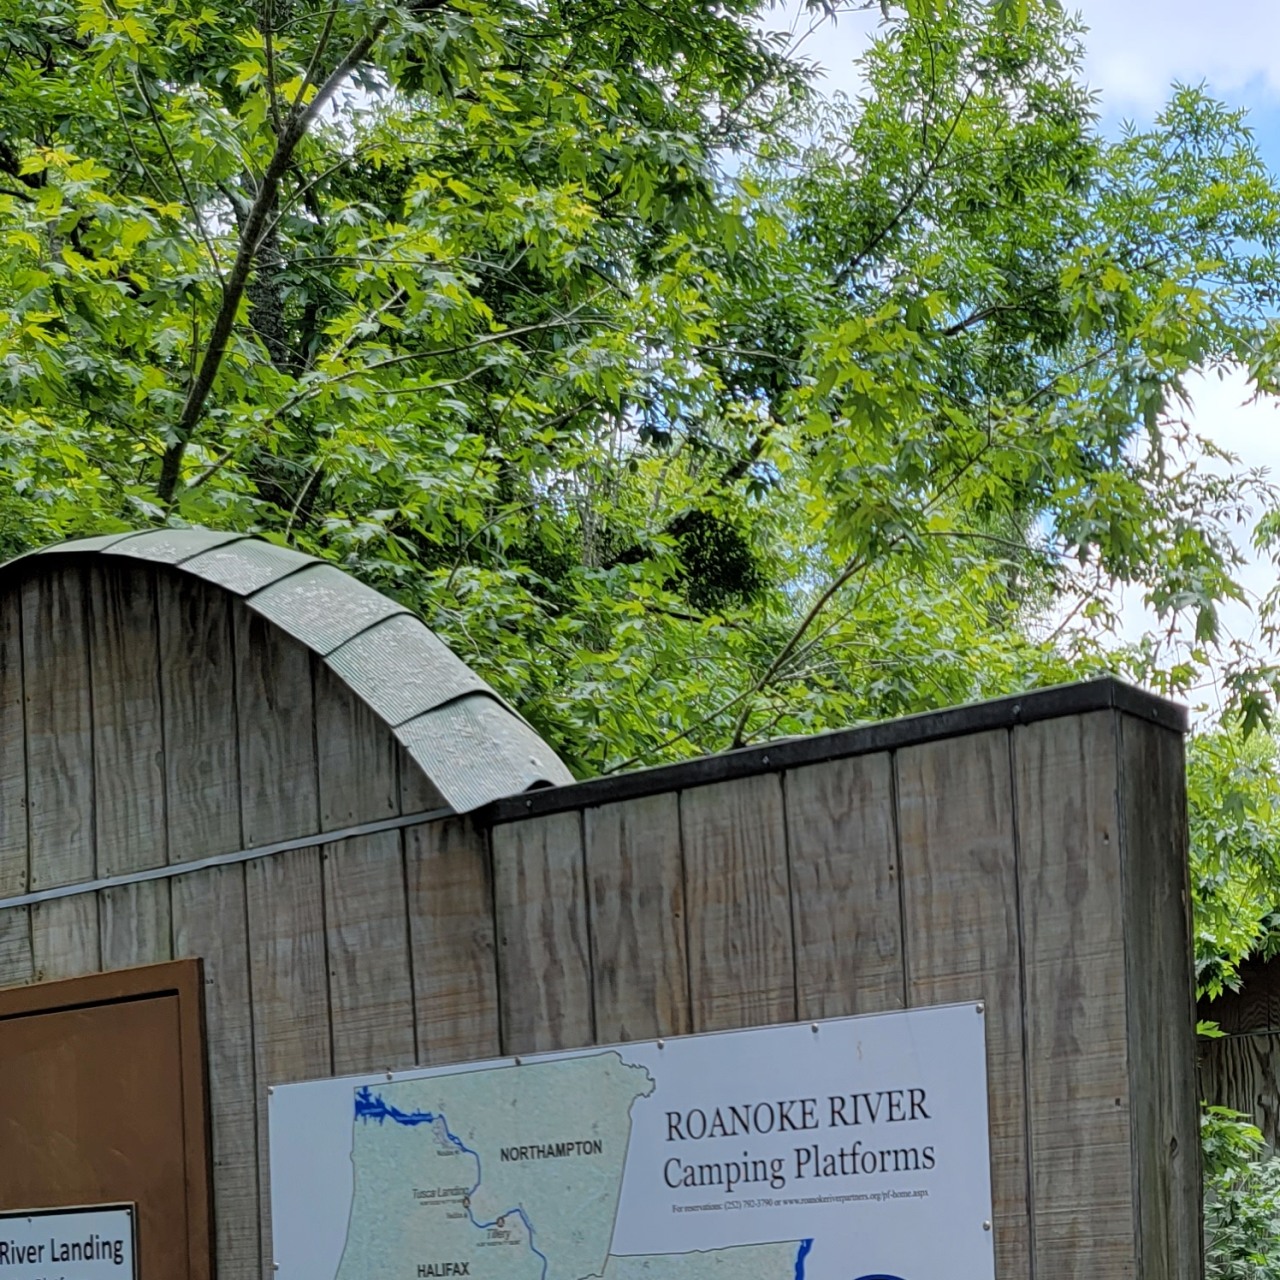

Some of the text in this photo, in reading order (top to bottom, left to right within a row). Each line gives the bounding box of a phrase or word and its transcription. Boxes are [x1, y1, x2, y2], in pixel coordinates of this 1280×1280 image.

[665, 1087, 931, 1141] ROANOKE RIVER
[500, 1139, 603, 1162] NORTHAMPTON
[663, 1141, 936, 1193] Camping Platforms
[672, 1204, 683, 1213] For
[724, 1201, 742, 1211] (252)
[486, 1228, 512, 1240] Tillery
[0, 1234, 124, 1265] River Landing
[417, 1262, 471, 1278] HALIFAX
